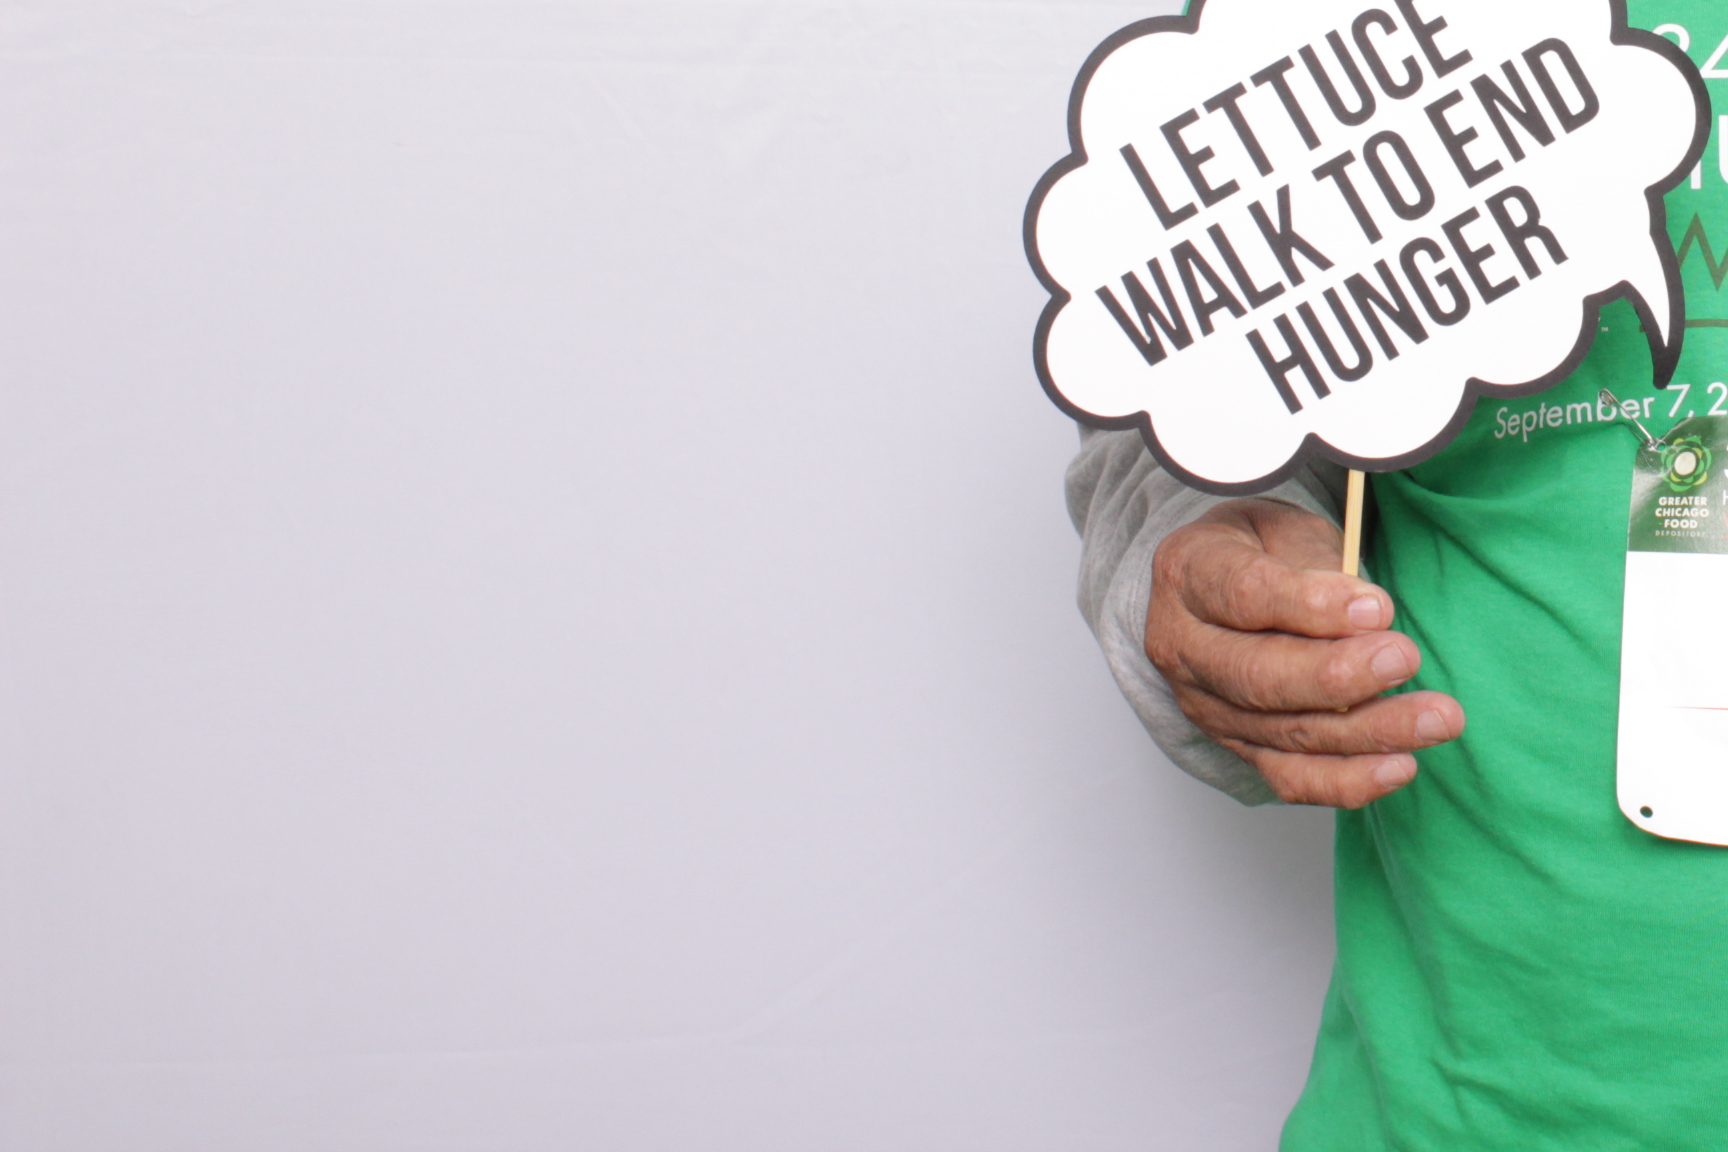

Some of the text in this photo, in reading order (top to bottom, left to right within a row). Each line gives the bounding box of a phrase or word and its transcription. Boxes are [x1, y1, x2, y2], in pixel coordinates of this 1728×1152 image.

[1095, 37, 1600, 367] WALK TO END
[1245, 185, 1569, 415] HUNGER
[1494, 390, 1655, 443] September
[1666, 383, 1695, 419] 7,
[1658, 496, 1708, 507] GREATER
[1655, 507, 1710, 518] CHICAGO
[1664, 518, 1698, 529] FOOD
[1655, 530, 1706, 538] DEPOSITORY
